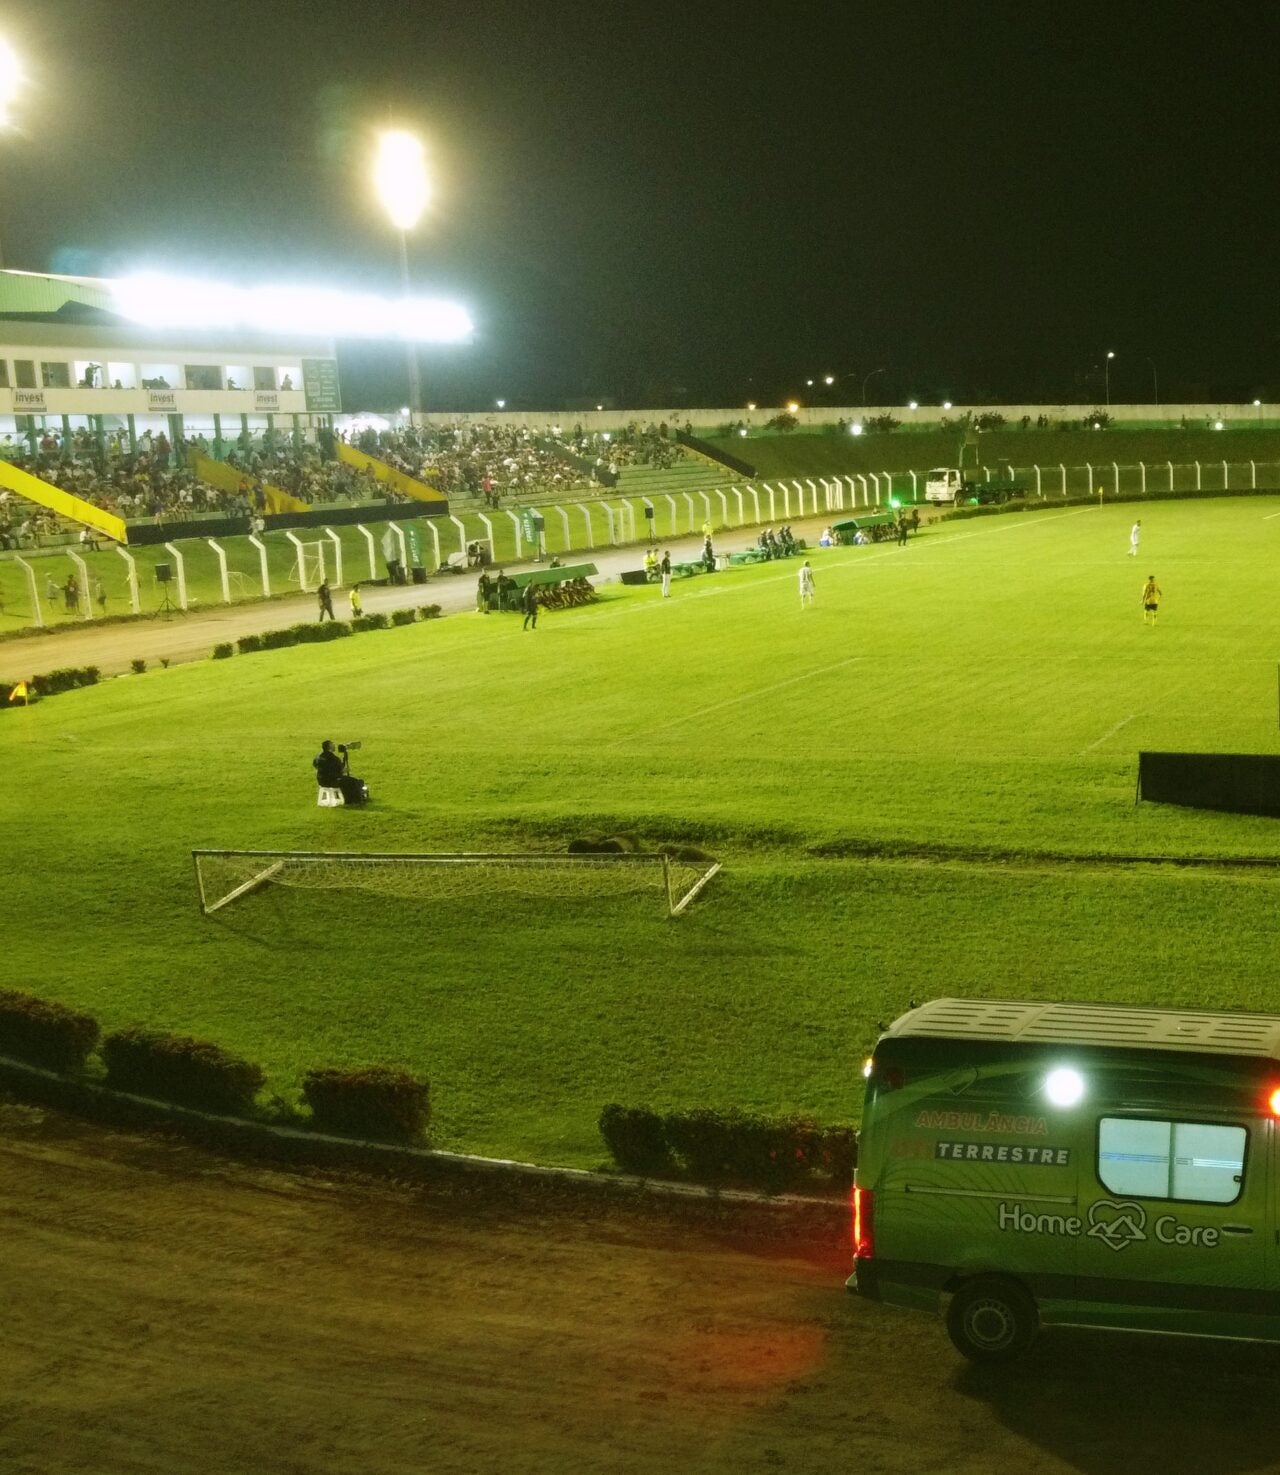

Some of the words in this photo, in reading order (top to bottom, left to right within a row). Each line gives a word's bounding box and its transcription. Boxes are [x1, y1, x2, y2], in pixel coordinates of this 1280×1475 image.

[15, 391, 44, 403] invest
[150, 392, 175, 403] invest
[916, 1110, 1049, 1135] AMBULÂNCIA
[938, 1143, 1069, 1164] TERRESTRE
[999, 1202, 1082, 1236] Home
[1155, 1215, 1219, 1247] Care
